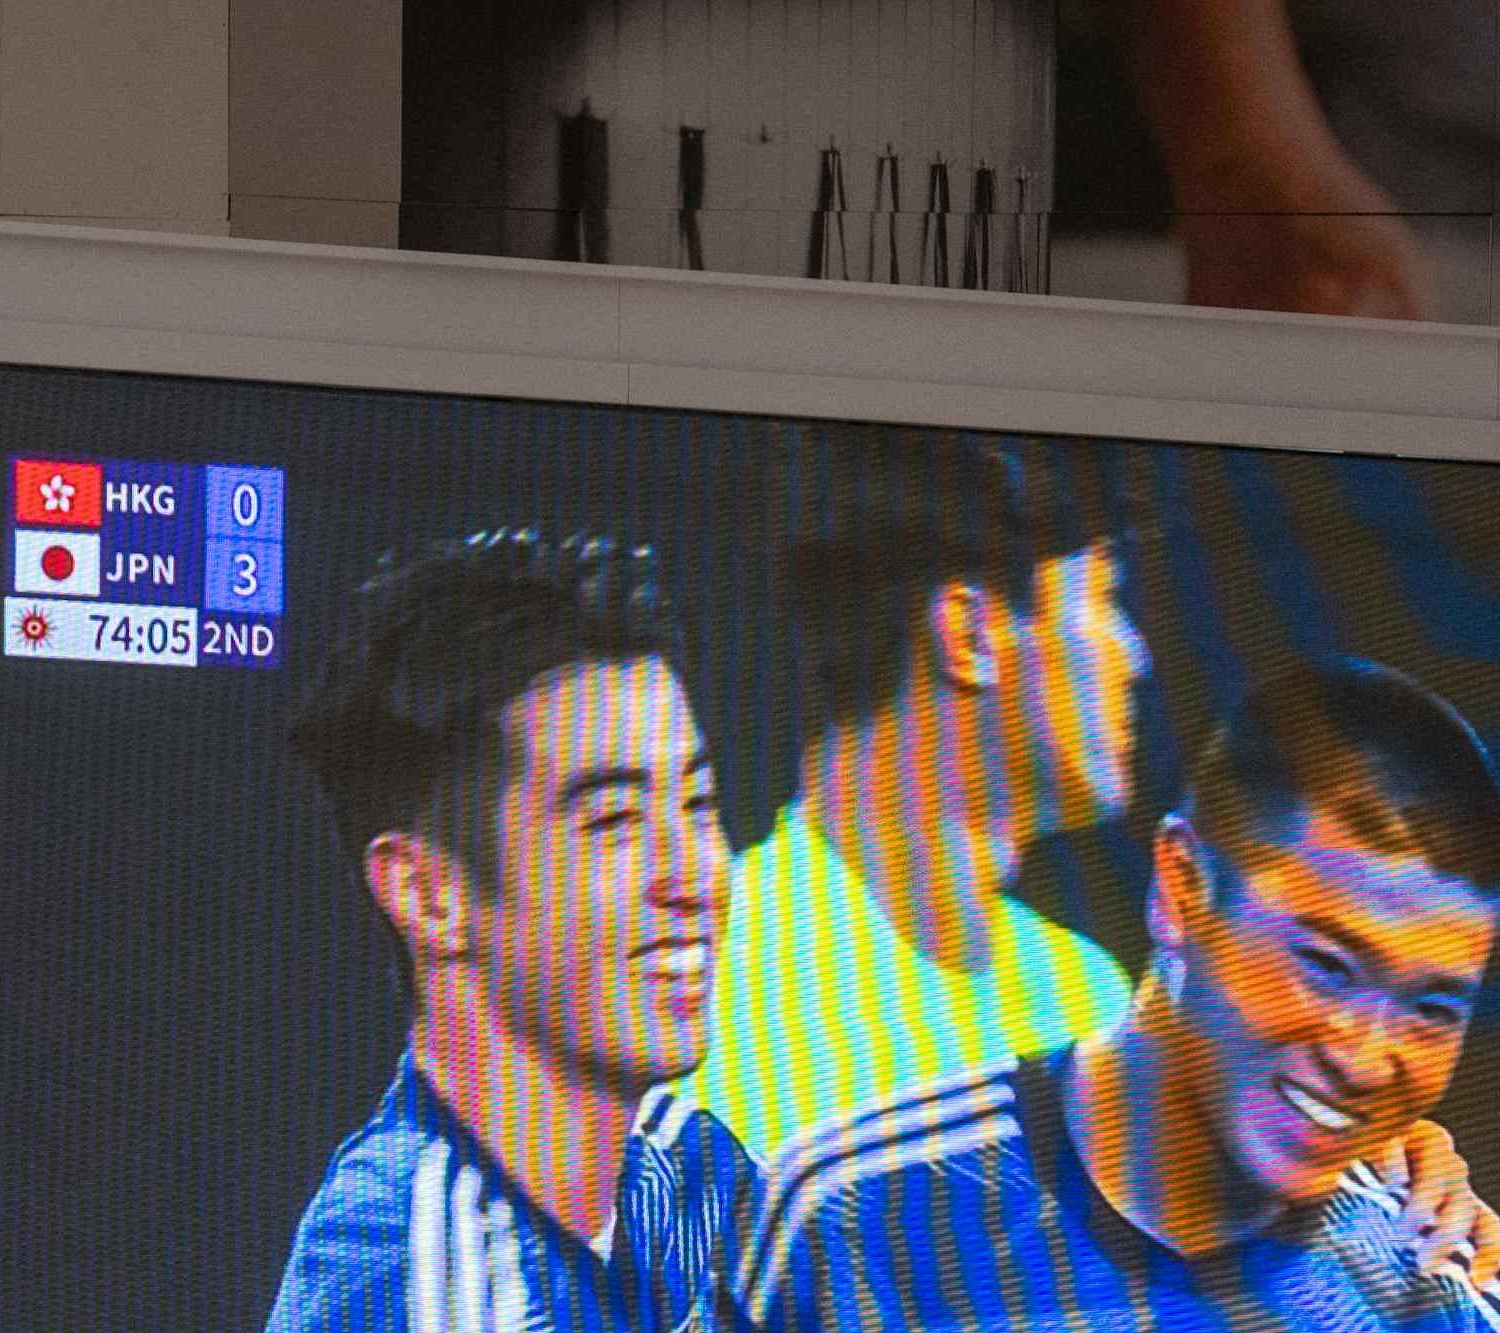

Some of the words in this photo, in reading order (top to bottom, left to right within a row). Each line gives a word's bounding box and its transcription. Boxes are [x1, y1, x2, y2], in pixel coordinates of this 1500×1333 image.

[105, 481, 175, 516] HKG
[232, 484, 258, 526] 0
[105, 553, 175, 585] JPN
[232, 554, 258, 596] 3
[89, 613, 191, 655] 74:05
[203, 622, 274, 656] 2ND
